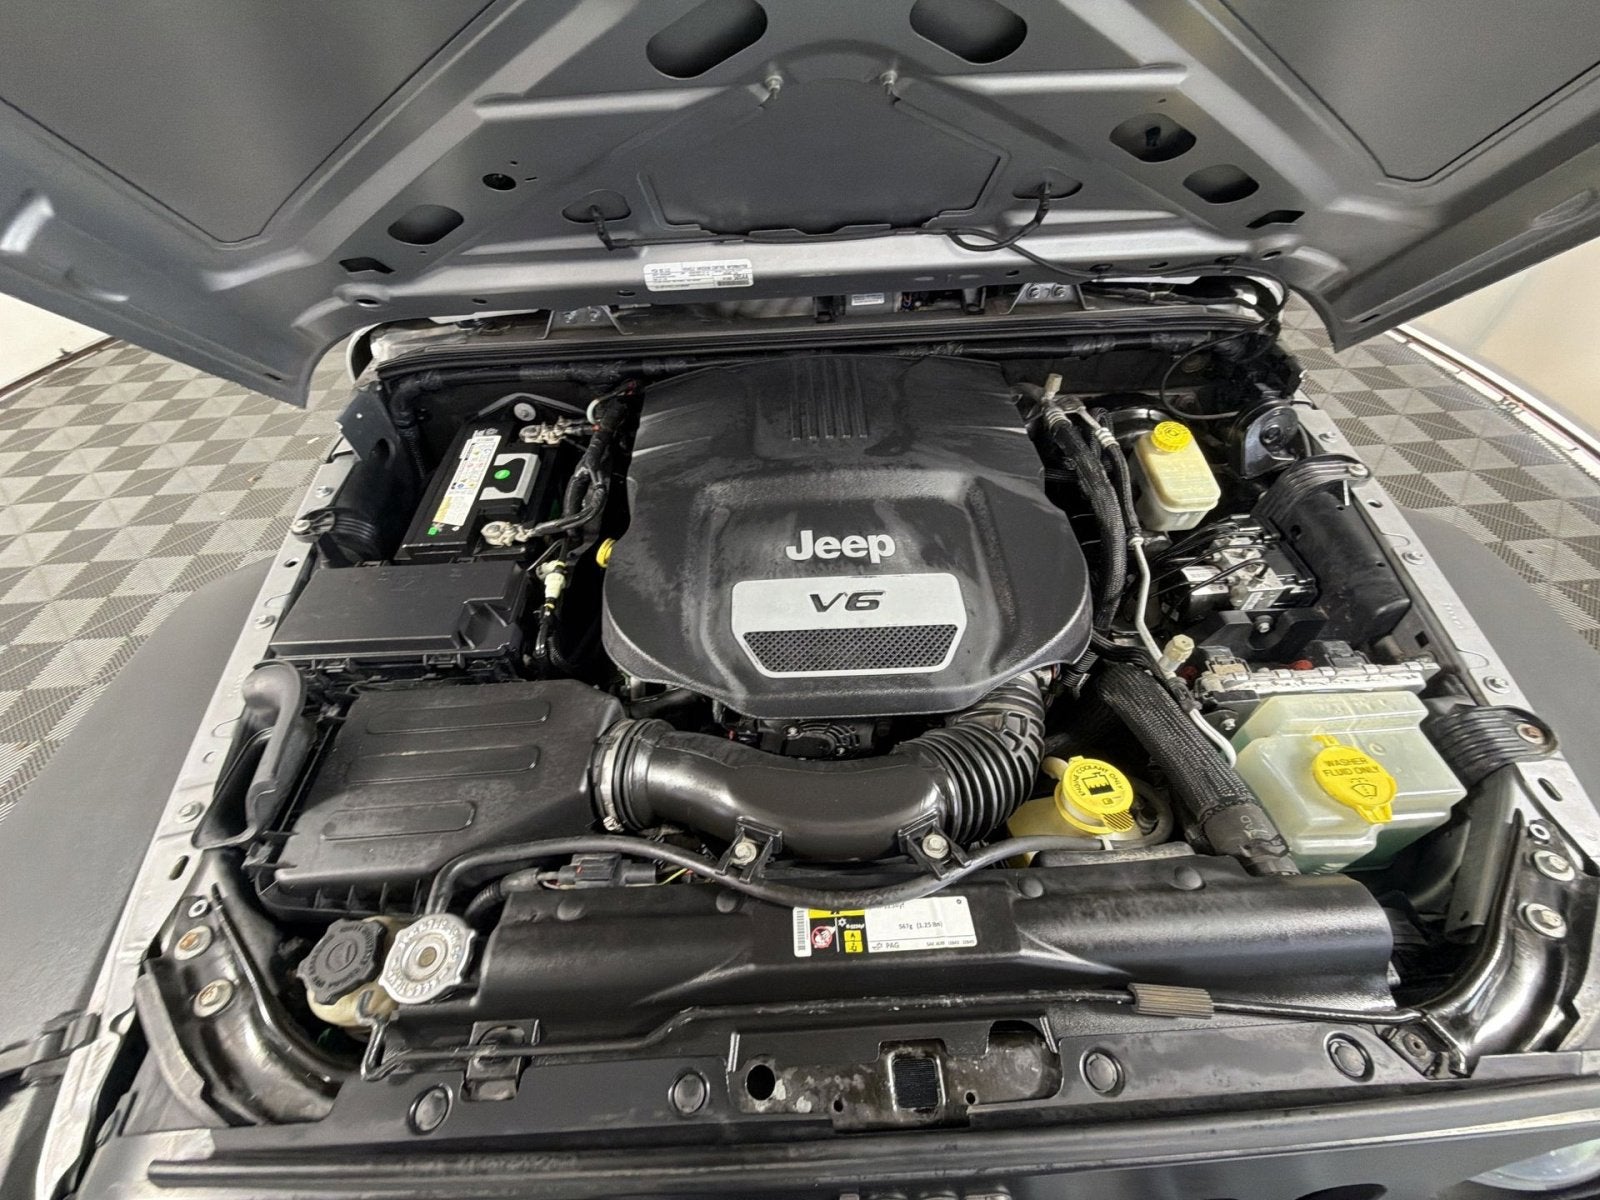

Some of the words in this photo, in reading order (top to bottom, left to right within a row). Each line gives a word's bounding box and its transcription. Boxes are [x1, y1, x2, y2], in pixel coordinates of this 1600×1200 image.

[786, 530, 895, 564] Jeep
[809, 591, 885, 612] V6
[1322, 768, 1353, 776] FLUID
[1355, 766, 1380, 774] ONLY
[1324, 757, 1367, 767] WASHER
[1076, 765, 1108, 774] COOLANT
[1109, 773, 1123, 789] ONLY
